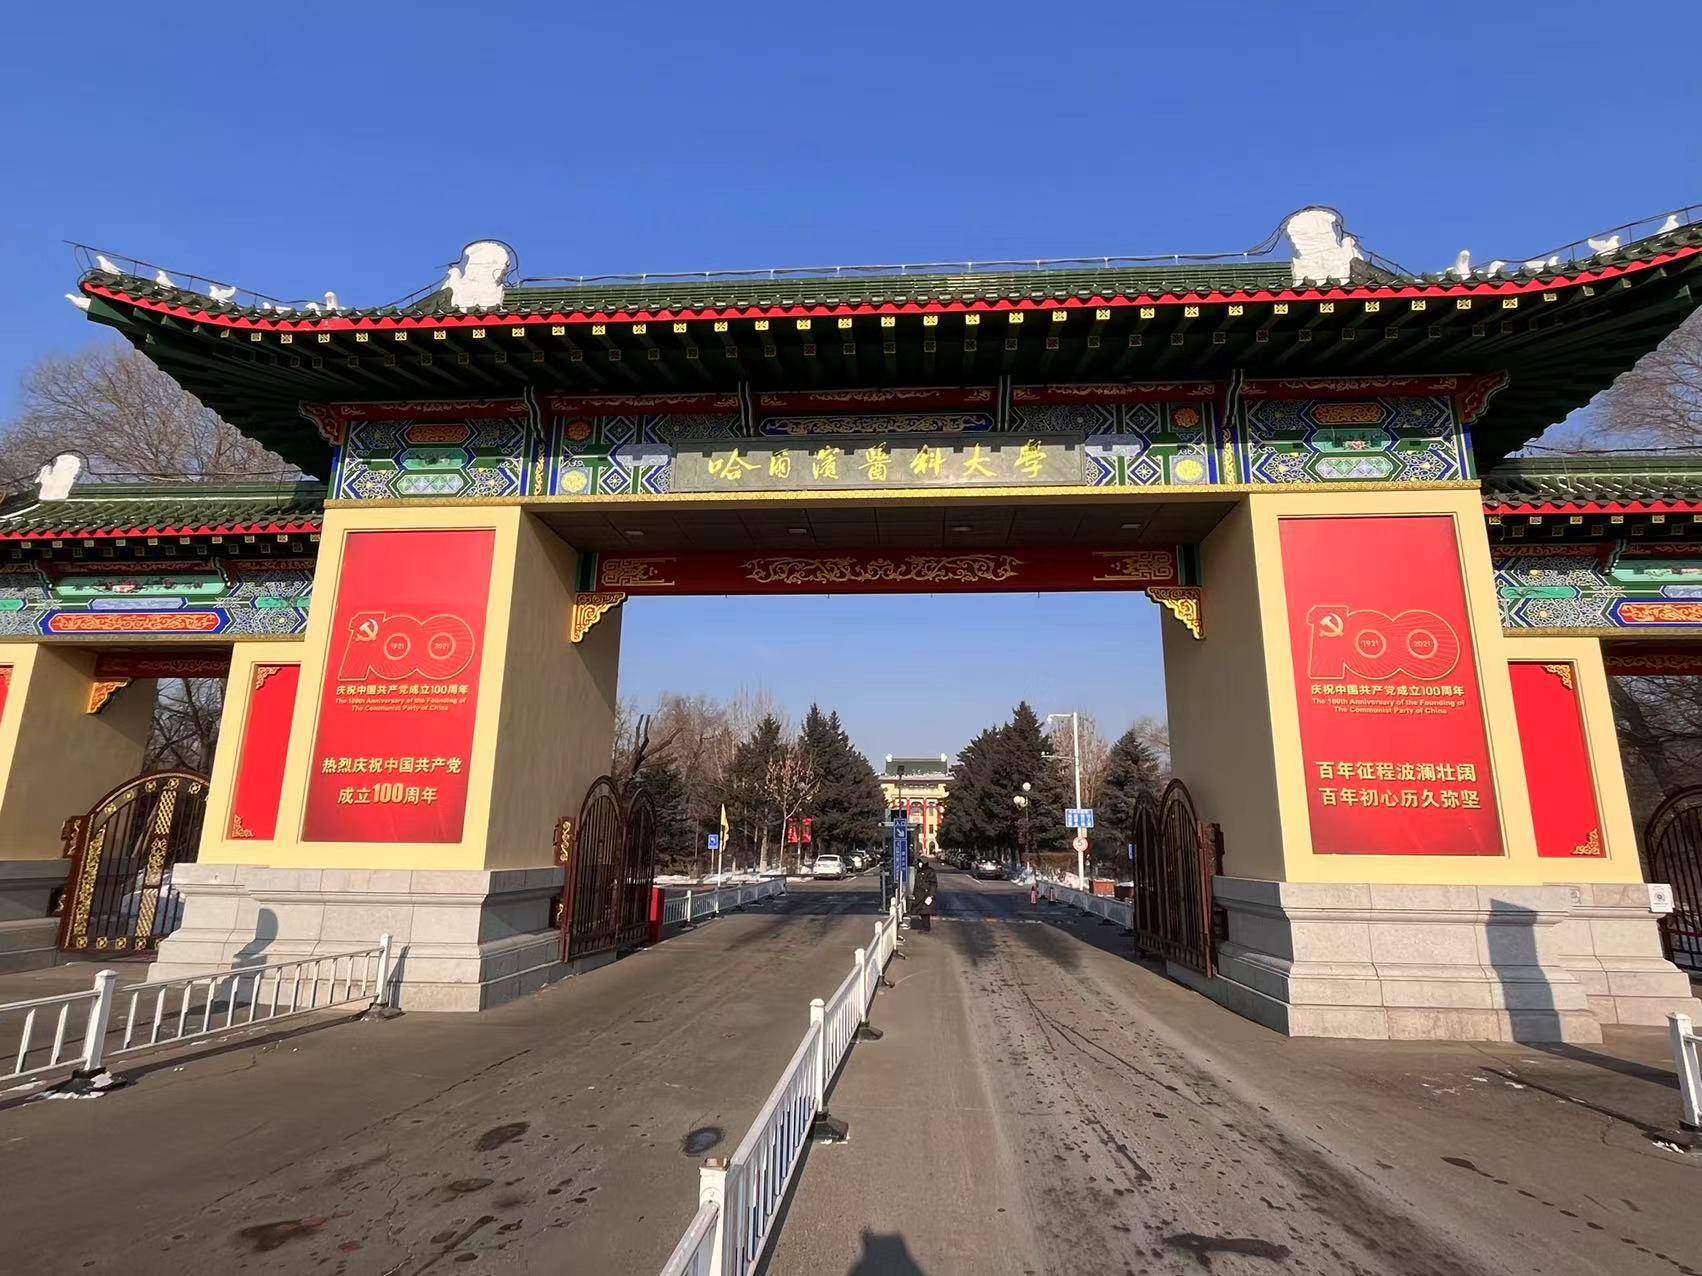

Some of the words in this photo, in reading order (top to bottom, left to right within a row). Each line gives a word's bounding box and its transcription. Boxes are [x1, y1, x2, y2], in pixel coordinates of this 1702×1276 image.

[1361, 640, 1379, 648] 1921
[1413, 640, 1431, 648] 2021
[336, 684, 469, 696] 庆祝中国共产党成立100周年
[1311, 684, 1465, 697] 庆祝中国共产党成立100周年
[365, 698, 403, 706] Anniversary
[1349, 698, 1394, 707] Anniversary
[1420, 699, 1456, 708] Founding
[1393, 707, 1415, 715] Party
[321, 757, 462, 774] 热烈庆祝中国共产党
[1315, 761, 1477, 782] 百年征程波澜壮阔
[337, 783, 438, 804] 成立100周年
[1318, 787, 1481, 809] 百年初心历久弥坚
